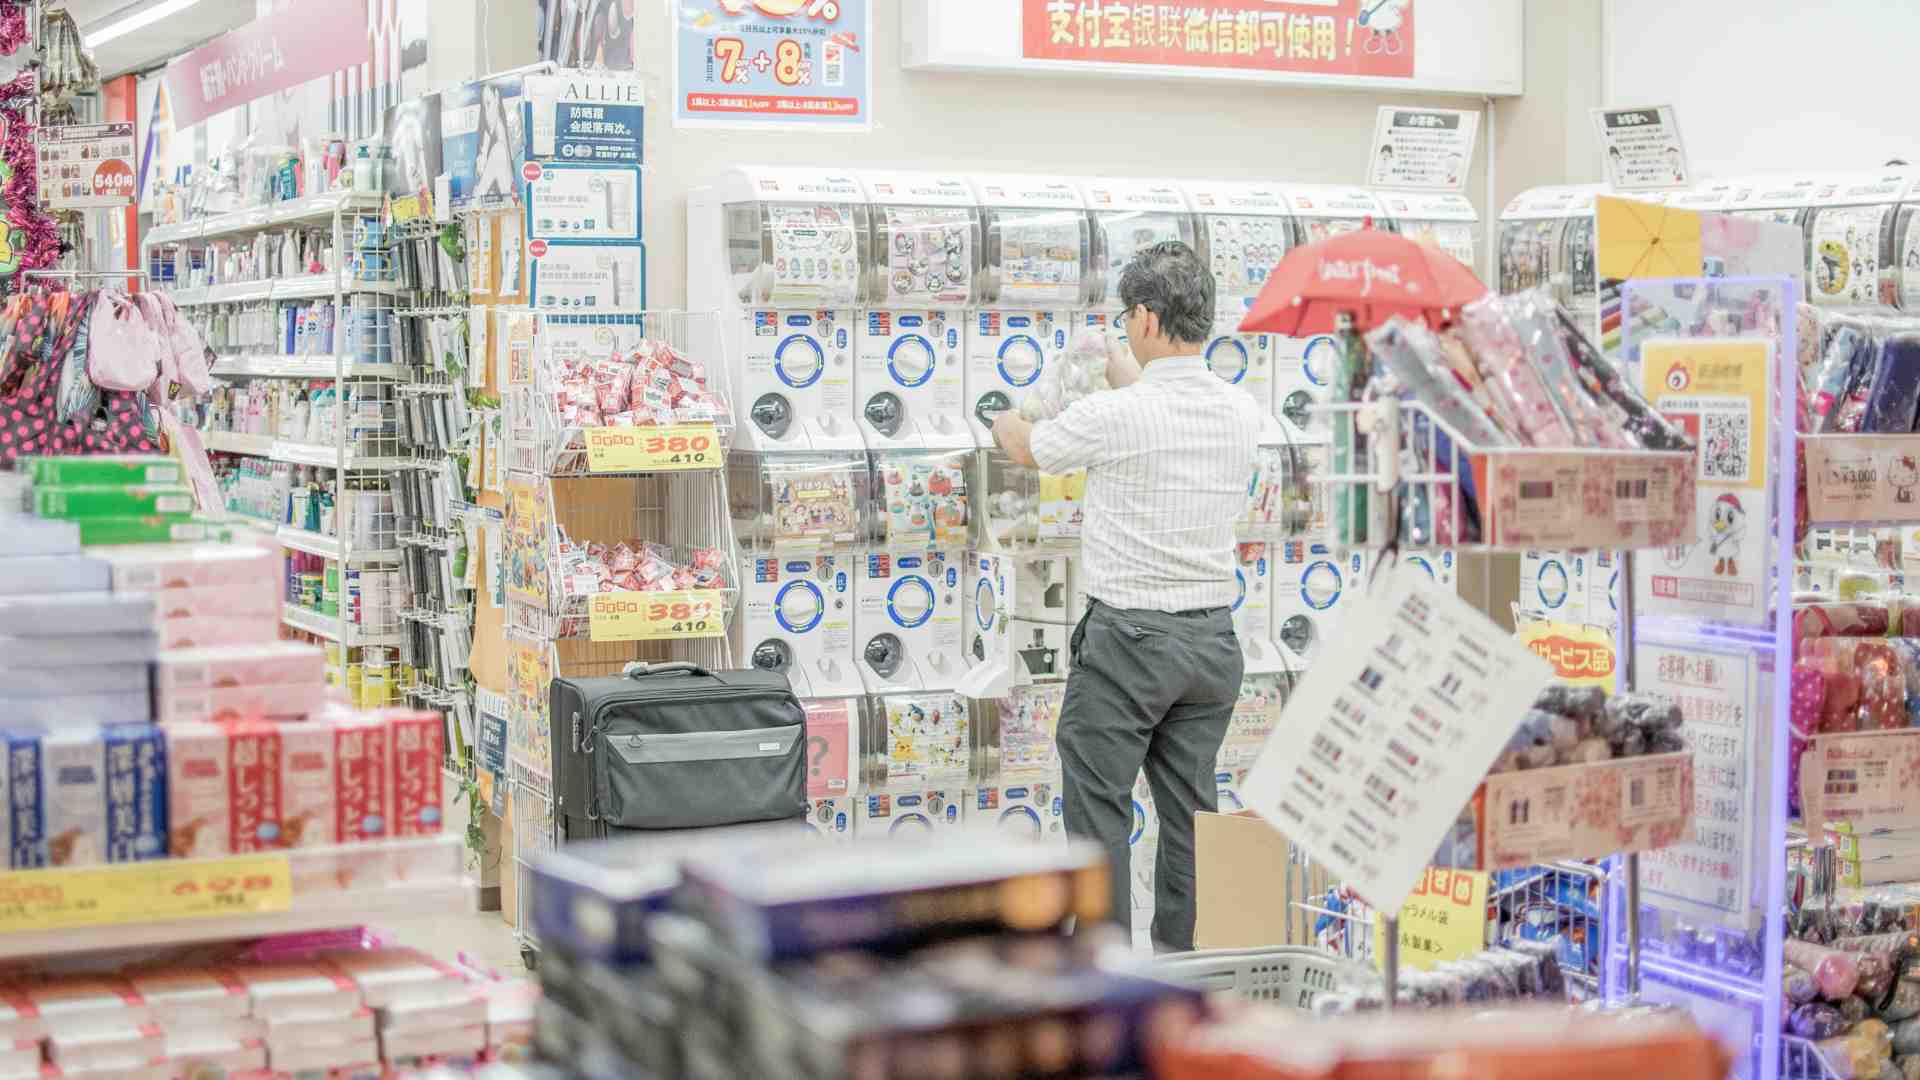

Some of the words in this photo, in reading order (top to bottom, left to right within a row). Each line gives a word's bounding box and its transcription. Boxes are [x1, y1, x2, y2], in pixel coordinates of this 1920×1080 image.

[565, 82, 639, 102] ALLIE
[644, 435, 710, 454] 380
[670, 453, 705, 463] 410
[671, 621, 706, 632] 410
